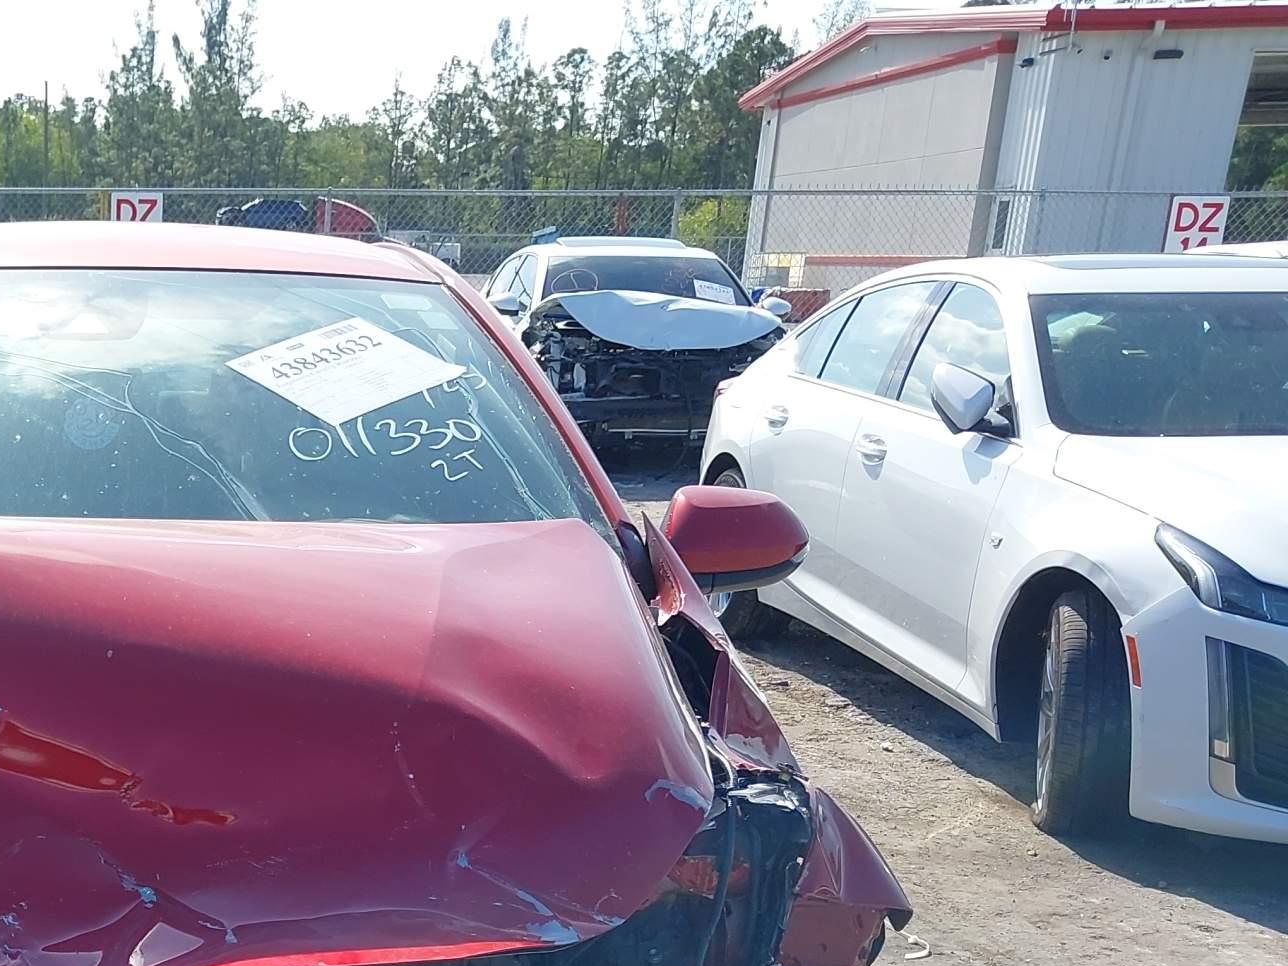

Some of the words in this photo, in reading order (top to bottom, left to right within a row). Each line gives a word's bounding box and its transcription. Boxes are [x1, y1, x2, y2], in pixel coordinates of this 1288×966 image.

[116, 198, 158, 222] DZ
[1174, 202, 1224, 232] DZ
[271, 334, 383, 383] 43843632
